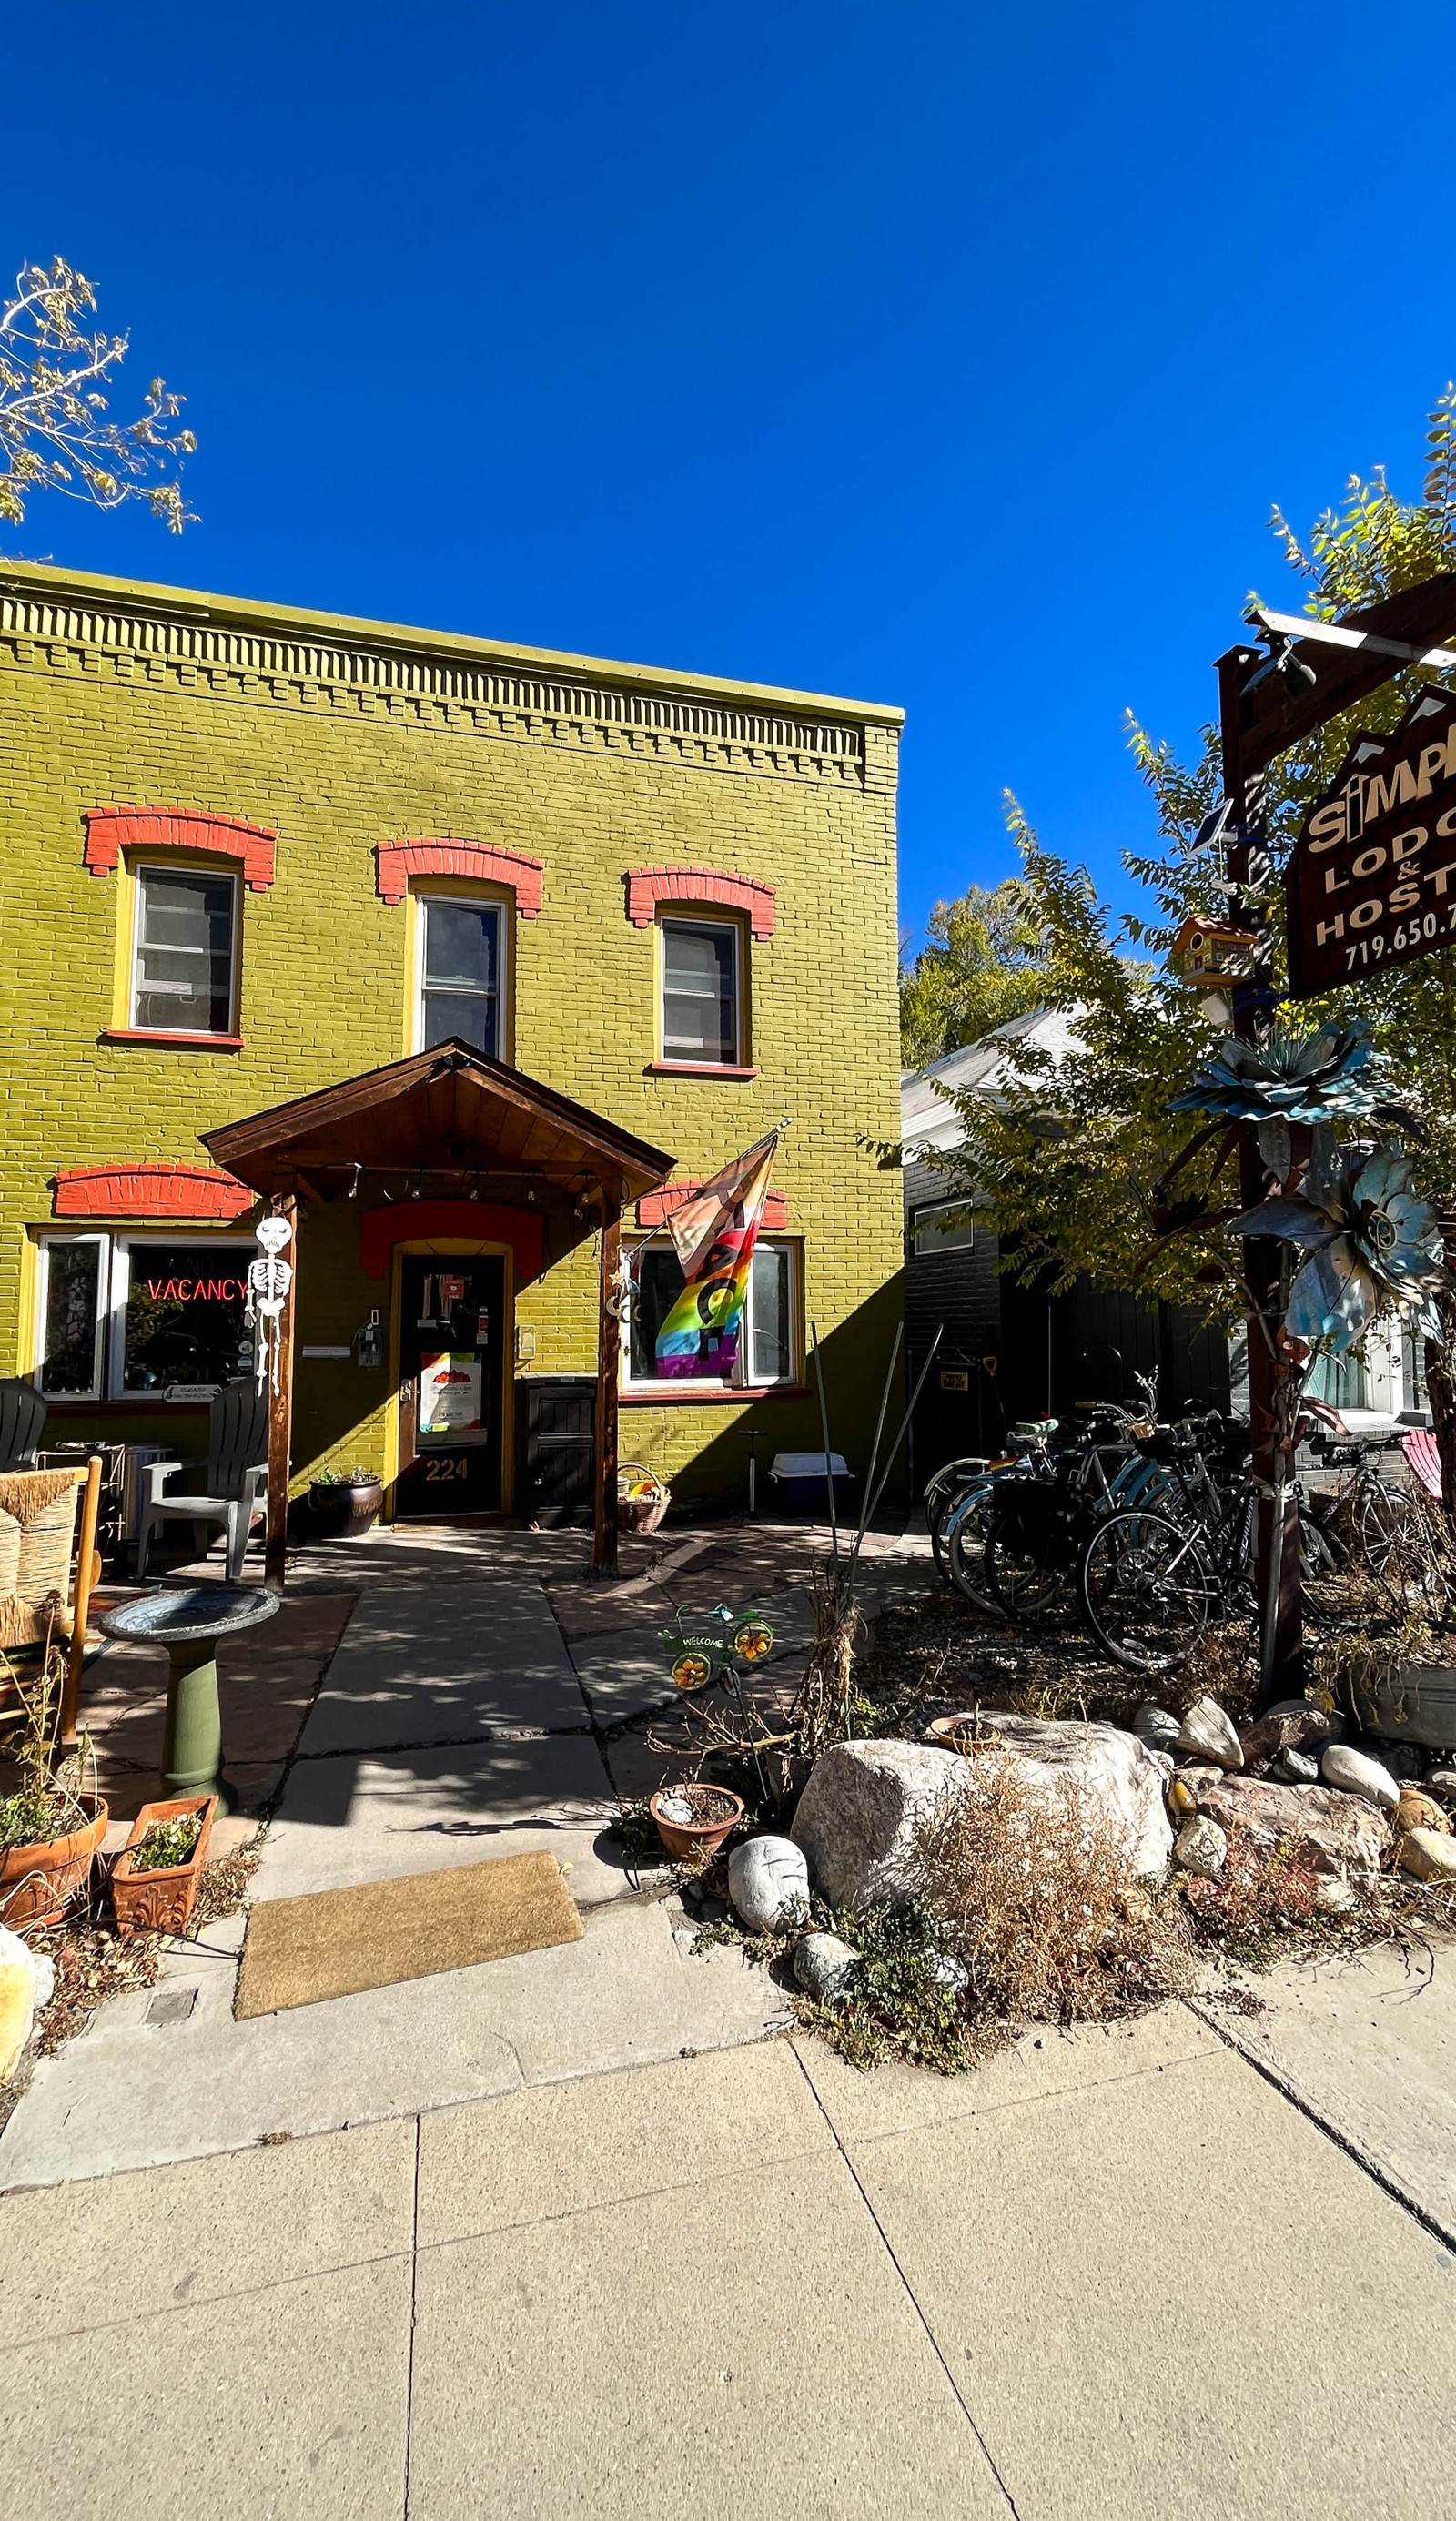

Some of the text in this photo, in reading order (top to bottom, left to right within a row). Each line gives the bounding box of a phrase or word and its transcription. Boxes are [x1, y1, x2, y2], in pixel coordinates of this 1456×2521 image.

[1397, 860, 1420, 881] &
[147, 1279, 248, 1301] VACANCY
[425, 1457, 468, 1481] 224
[682, 1636, 724, 1649] WELCOME
